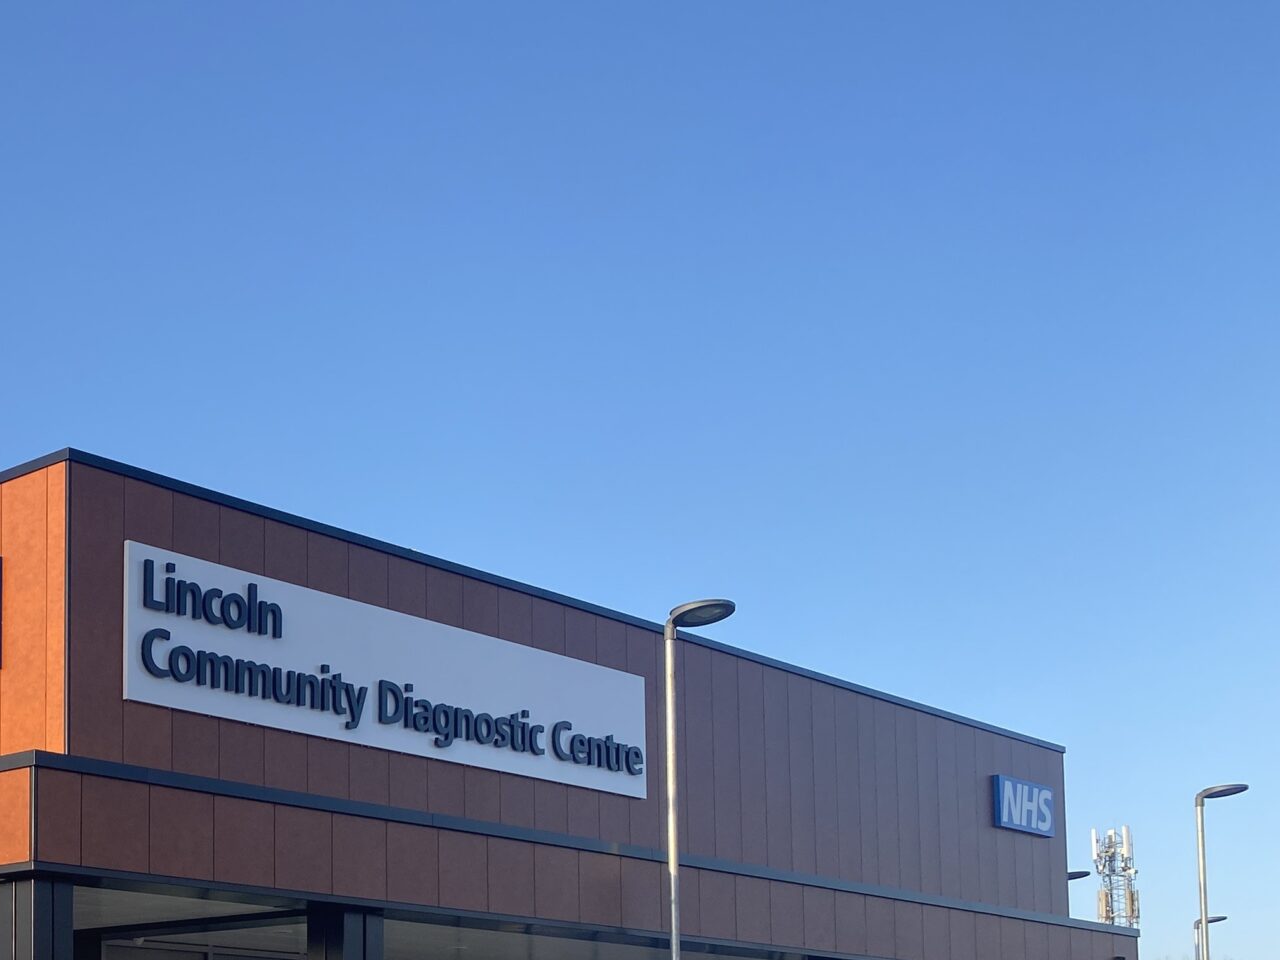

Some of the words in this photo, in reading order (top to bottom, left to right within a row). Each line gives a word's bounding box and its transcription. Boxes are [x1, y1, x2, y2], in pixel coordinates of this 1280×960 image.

[143, 558, 283, 639] Lincoln
[141, 628, 368, 730] Community
[378, 680, 546, 755] Diagnostic
[552, 720, 644, 776] Centre
[1002, 780, 1052, 832] NHS
